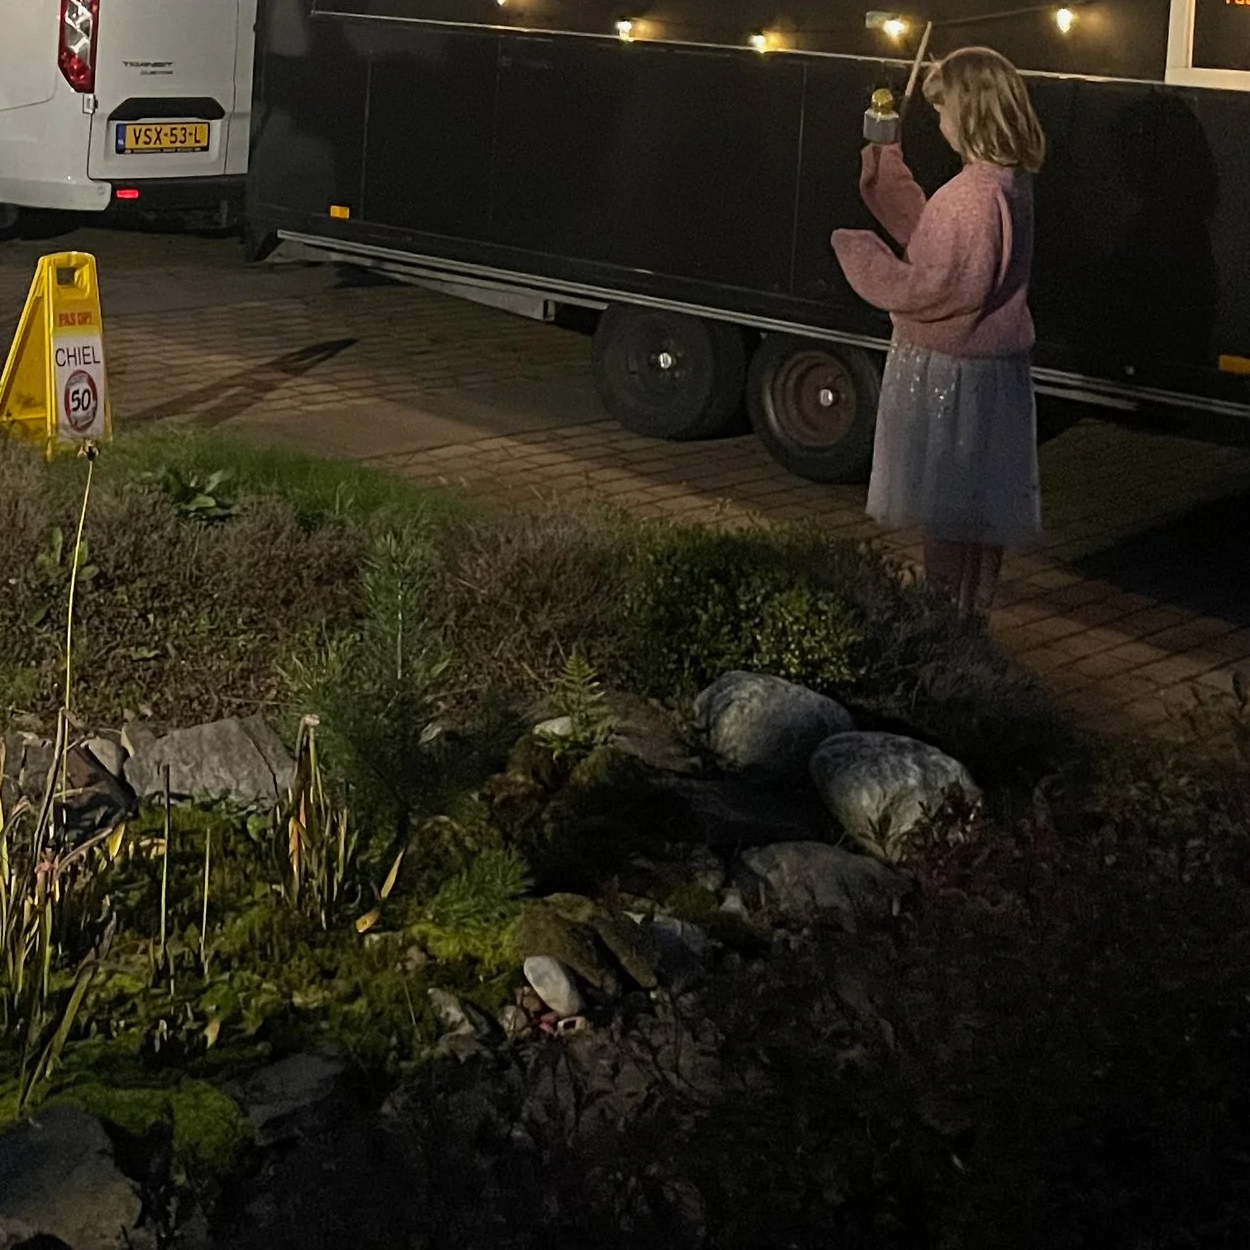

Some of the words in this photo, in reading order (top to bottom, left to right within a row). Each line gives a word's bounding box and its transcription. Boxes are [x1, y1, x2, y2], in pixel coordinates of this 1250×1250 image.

[133, 127, 201, 146] VSX-53-L
[55, 346, 100, 367] CHIEL
[71, 388, 91, 412] 50
